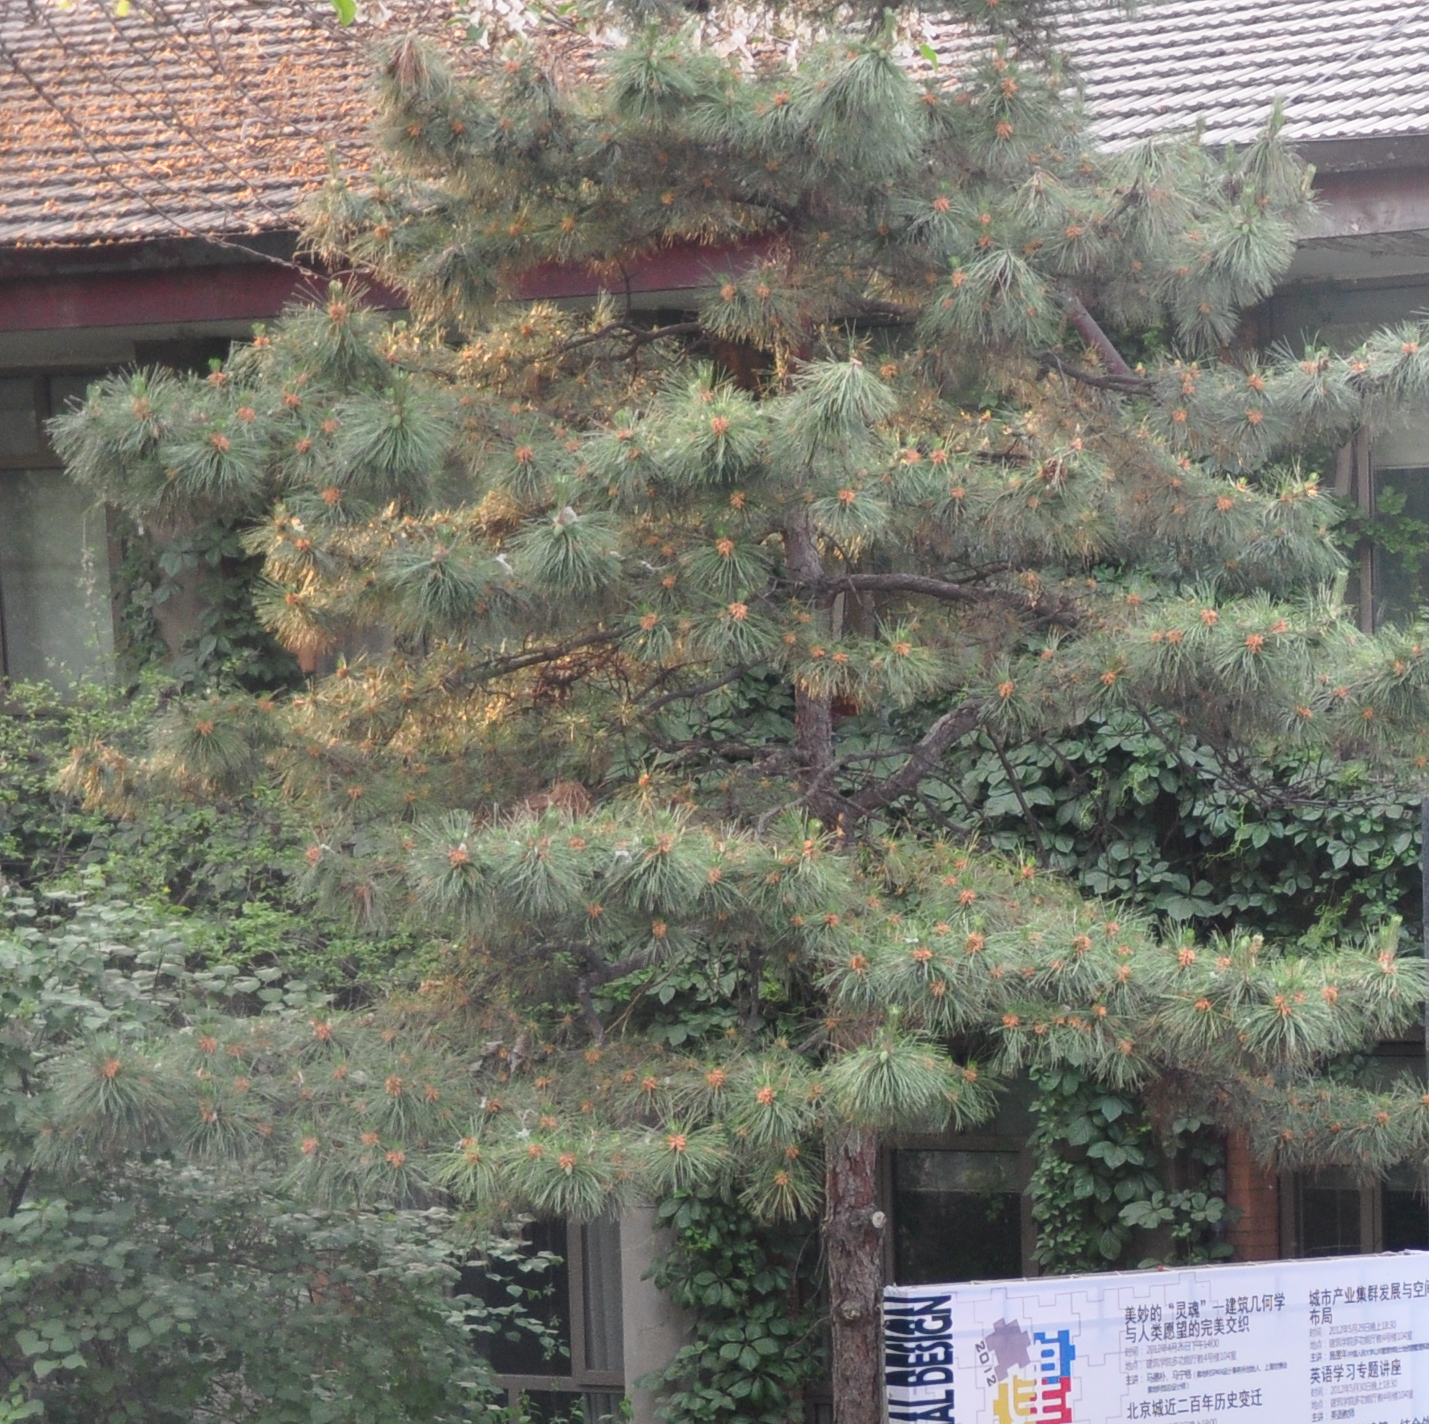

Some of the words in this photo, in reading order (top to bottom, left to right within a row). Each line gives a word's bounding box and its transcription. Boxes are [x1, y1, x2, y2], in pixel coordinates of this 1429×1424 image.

[1124, 1315, 1251, 1344] 与人类愿望的完美交织
[1309, 1306, 1333, 1326] 布局
[974, 1340, 997, 1388] 2012
[1310, 1358, 1402, 1385] 英语学习专题讲座
[1126, 1388, 1263, 1420] 北京城近二百年历史变迁
